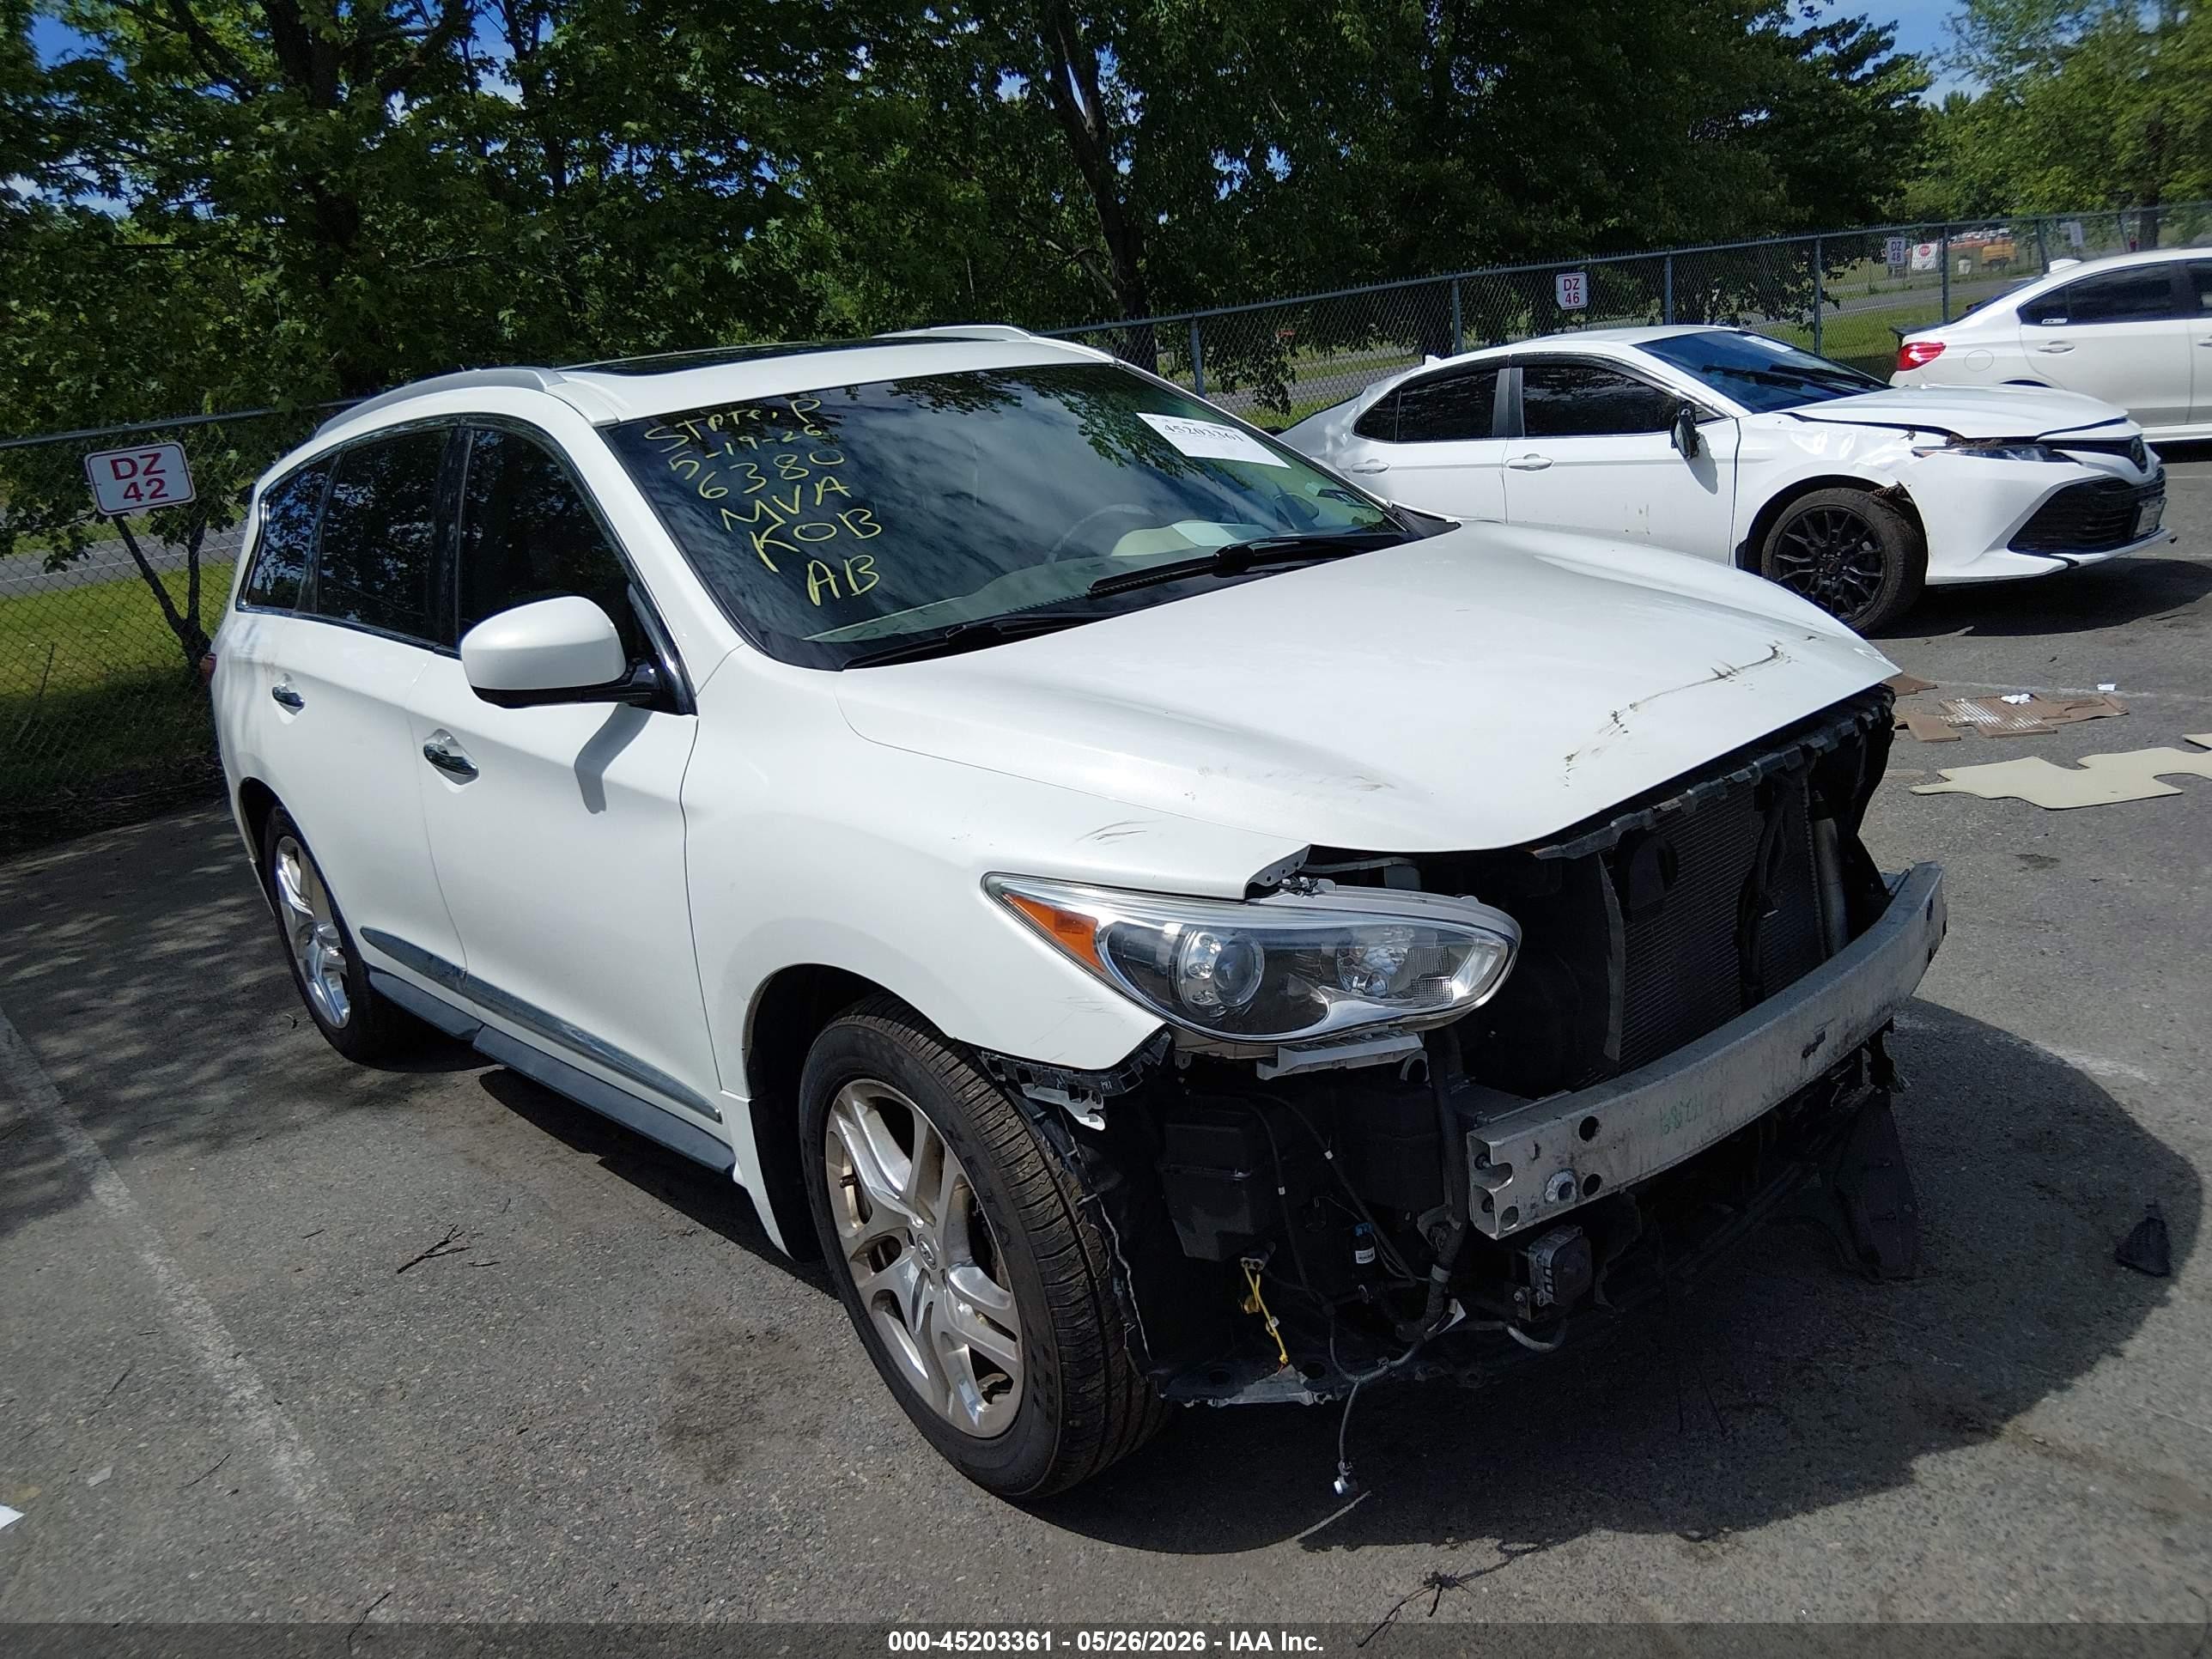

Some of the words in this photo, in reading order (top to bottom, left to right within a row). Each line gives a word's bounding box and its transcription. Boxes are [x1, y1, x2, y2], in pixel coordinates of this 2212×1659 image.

[1564, 278, 1580, 291] DZ
[1565, 292, 1580, 305] 46
[110, 453, 167, 481] DZ
[123, 477, 169, 502] 42
[720, 476, 852, 532] MVA
[750, 508, 882, 573] KOB
[807, 555, 880, 606] AB
